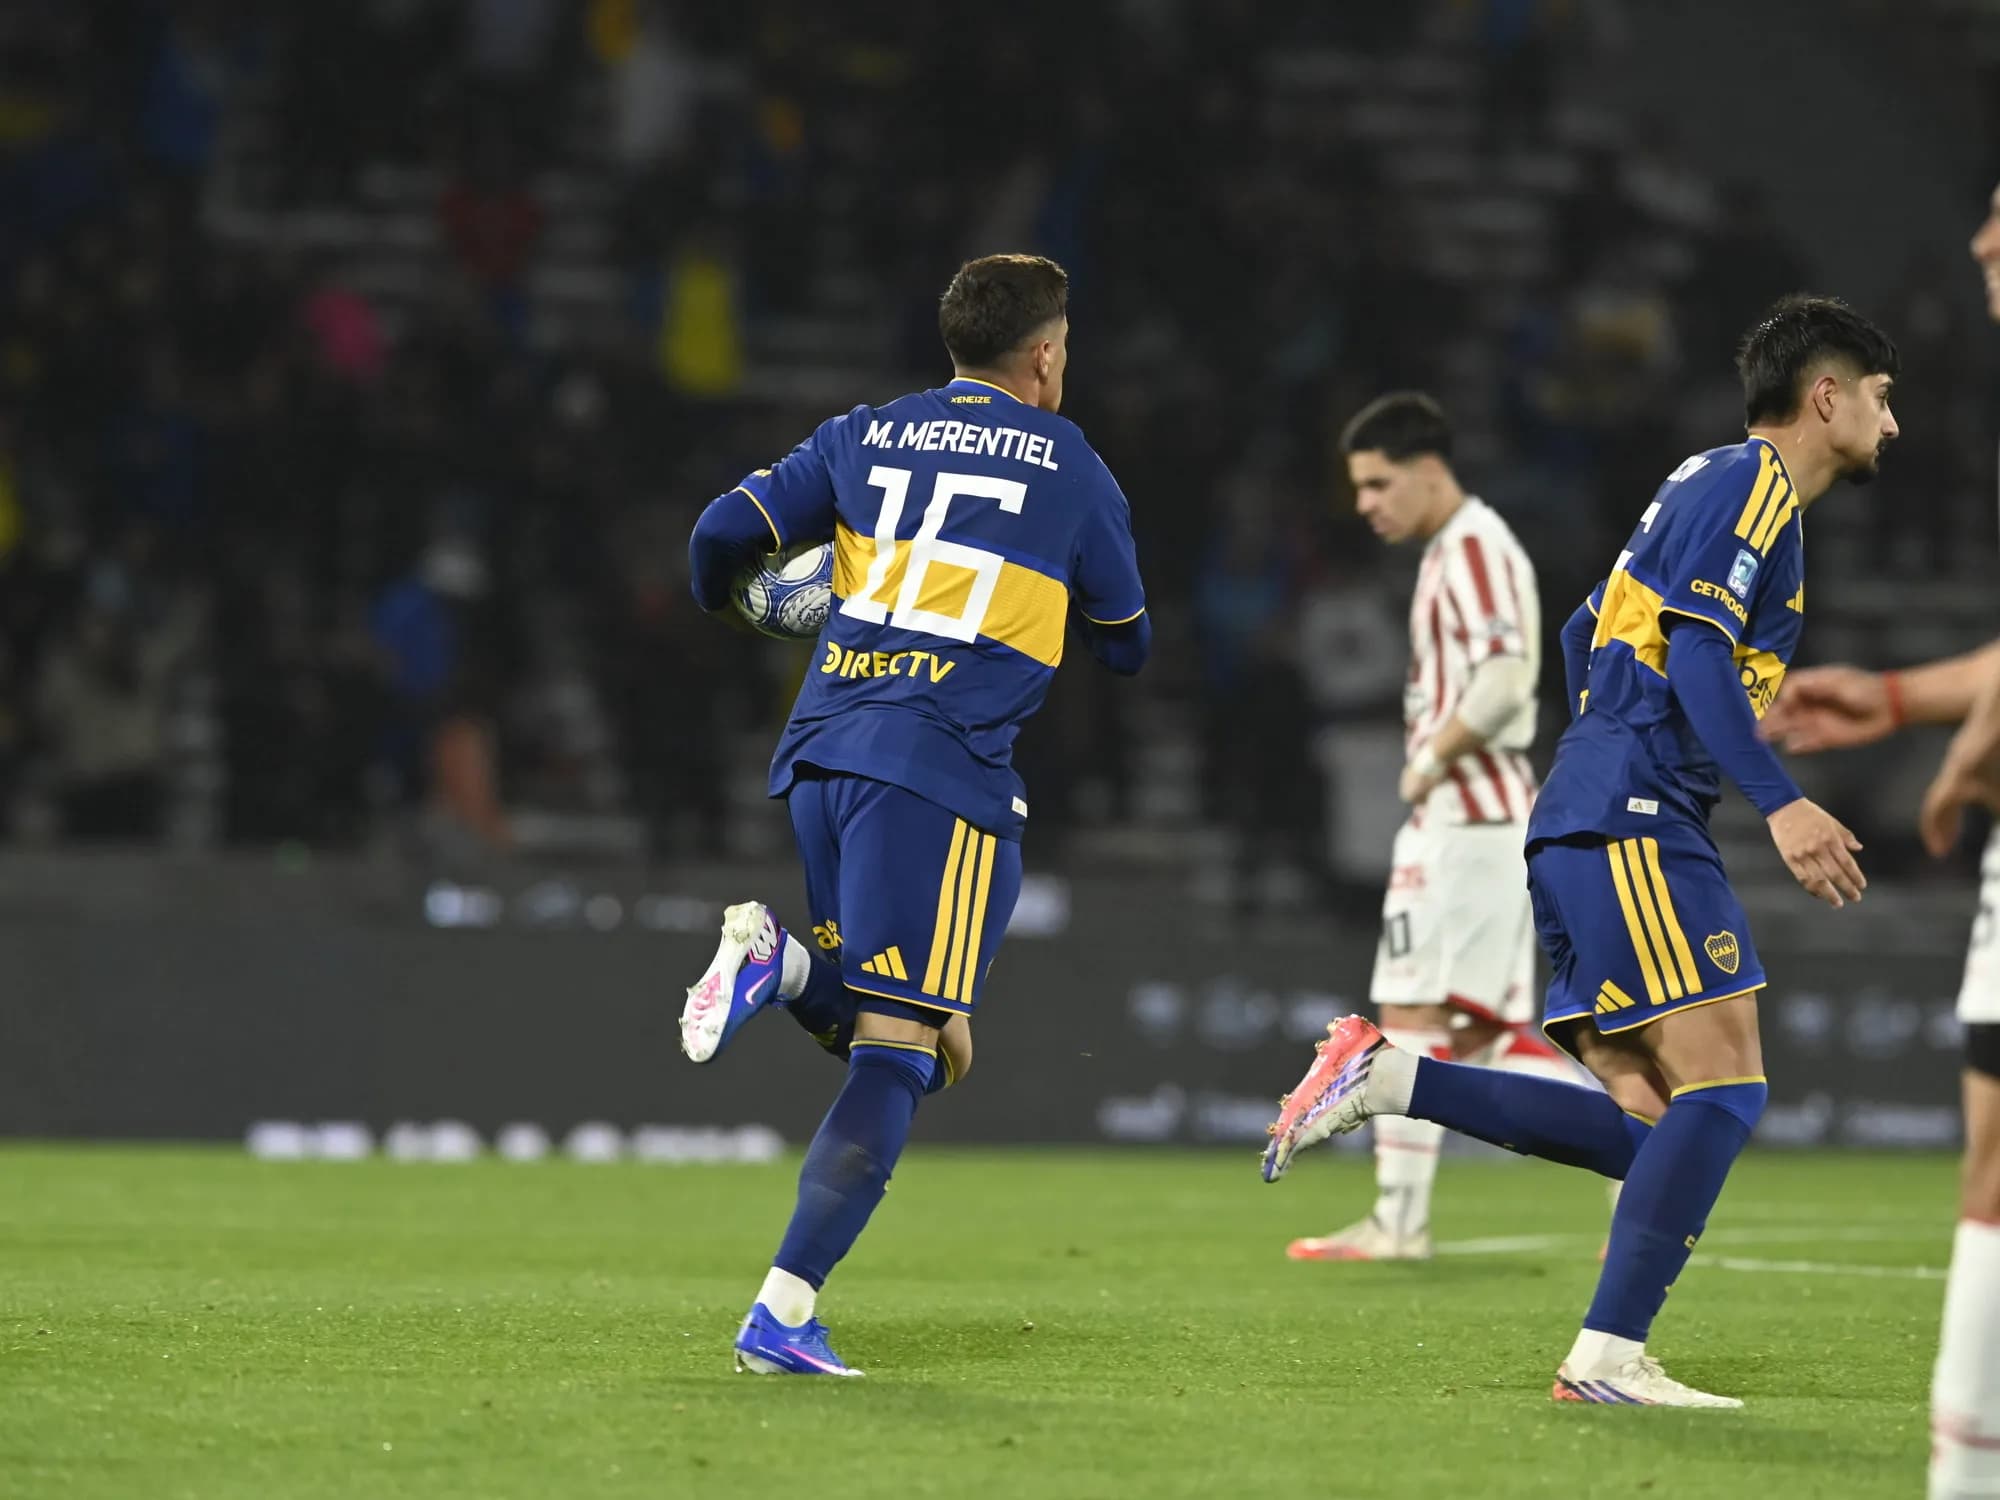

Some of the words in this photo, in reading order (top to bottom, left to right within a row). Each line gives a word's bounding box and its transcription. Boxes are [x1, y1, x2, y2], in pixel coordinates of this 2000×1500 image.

[951, 395, 992, 404] XENEIZE
[862, 420, 892, 449] M.
[898, 419, 1059, 471] MERENTIEL
[838, 465, 1028, 644] 16
[820, 641, 956, 683] DIRECTV
